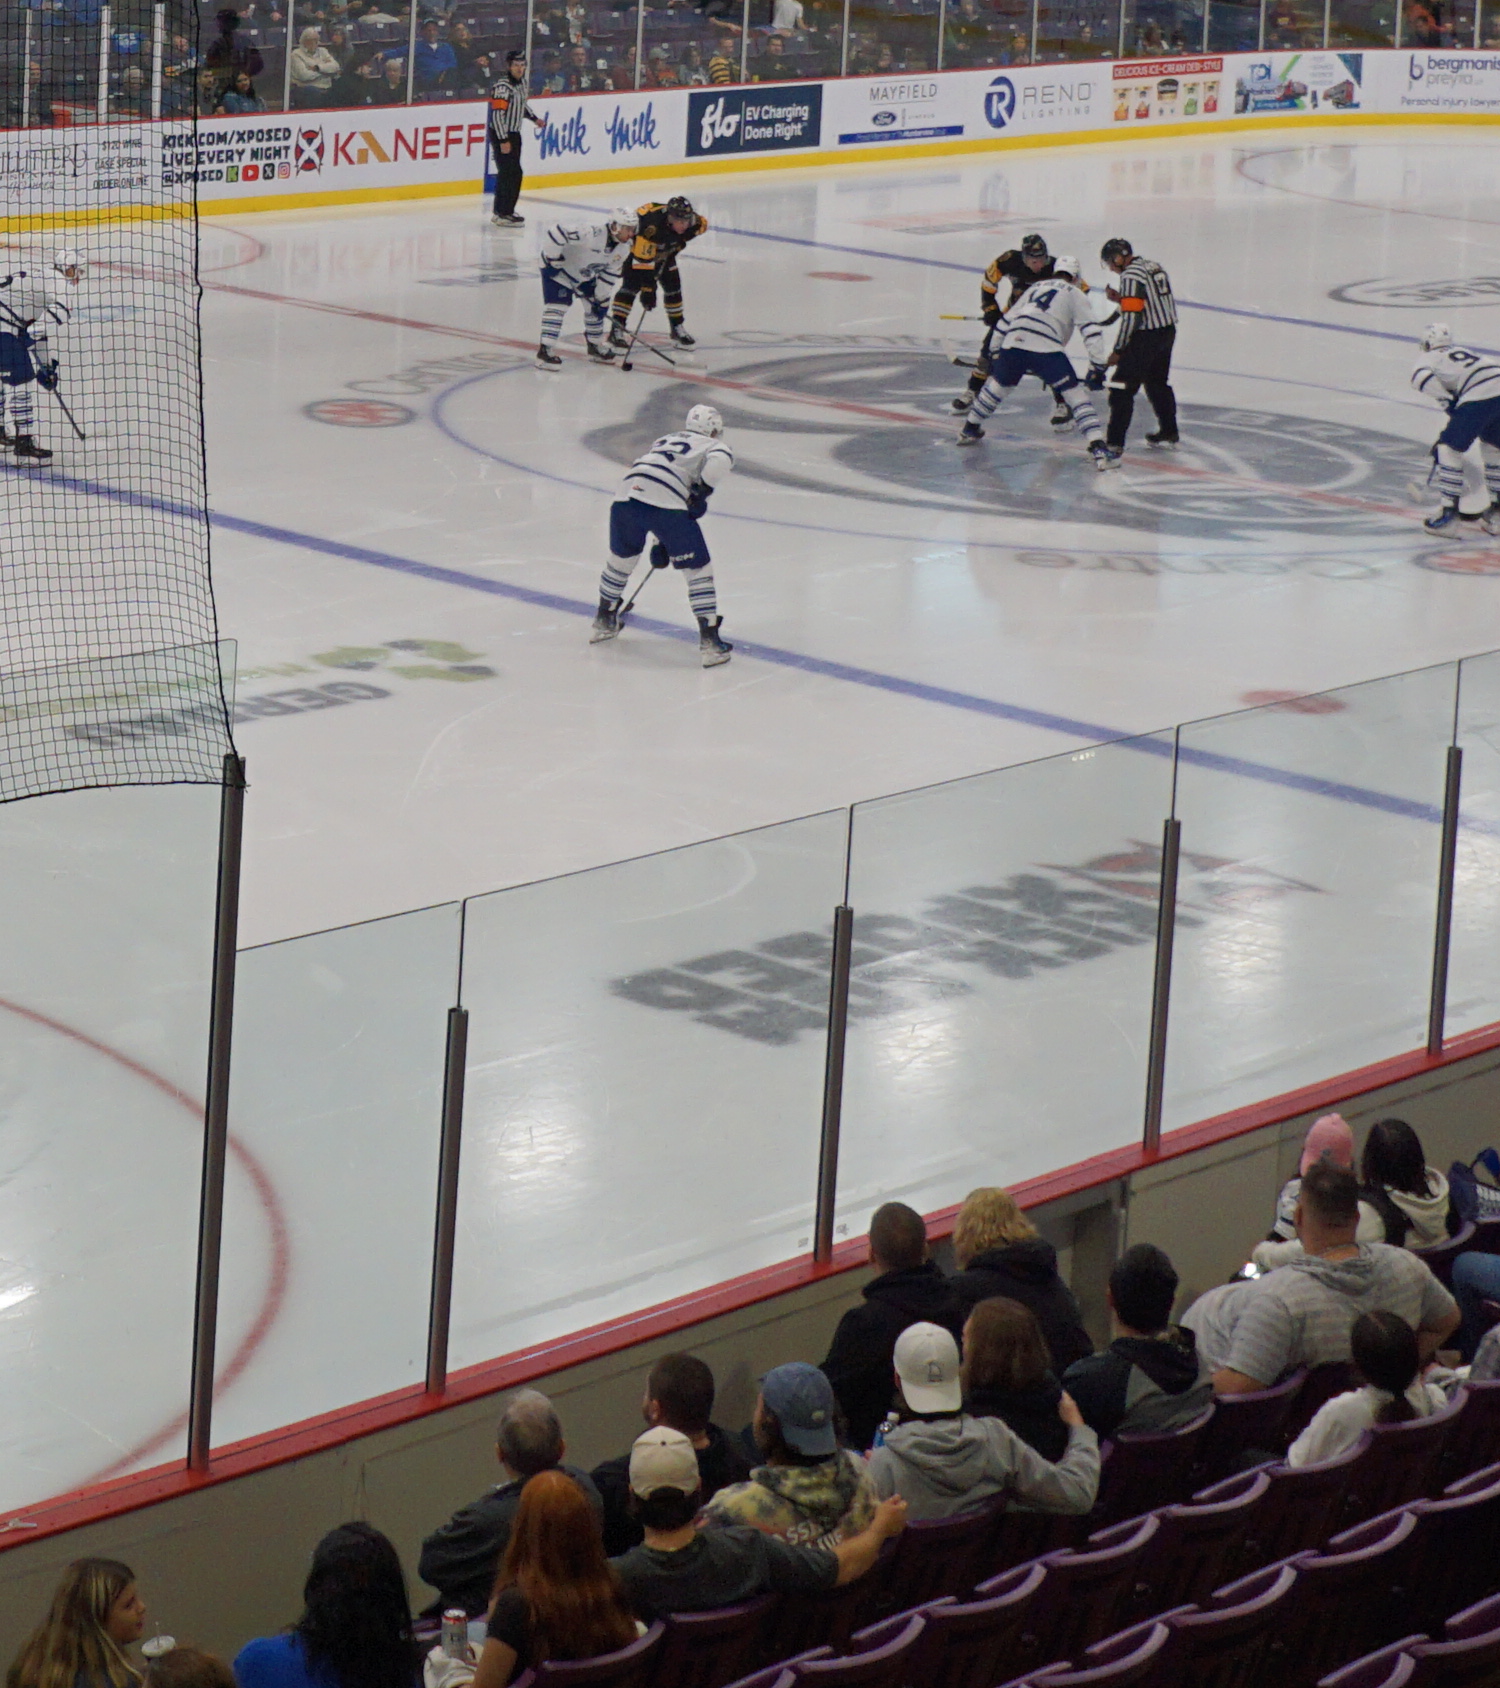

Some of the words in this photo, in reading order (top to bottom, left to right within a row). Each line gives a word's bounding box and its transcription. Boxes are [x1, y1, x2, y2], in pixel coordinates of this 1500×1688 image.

[869, 83, 938, 101] MAYFIELD
[1022, 82, 1092, 105] RENO
[1400, 95, 1440, 107] Personal
[701, 97, 740, 150] flo
[746, 106, 759, 122] EV
[760, 103, 809, 124] Charging
[1021, 106, 1091, 120] LIGHTING
[162, 127, 292, 150] KICKCOM/XPOSED
[536, 106, 590, 161] Milk
[606, 101, 660, 155] Milk
[745, 124, 772, 141] Done
[774, 122, 802, 141] Right
[162, 150, 194, 167] LIVE
[197, 147, 245, 166] EVERY
[249, 144, 291, 162] NIGHT
[332, 123, 486, 168] KANEFF
